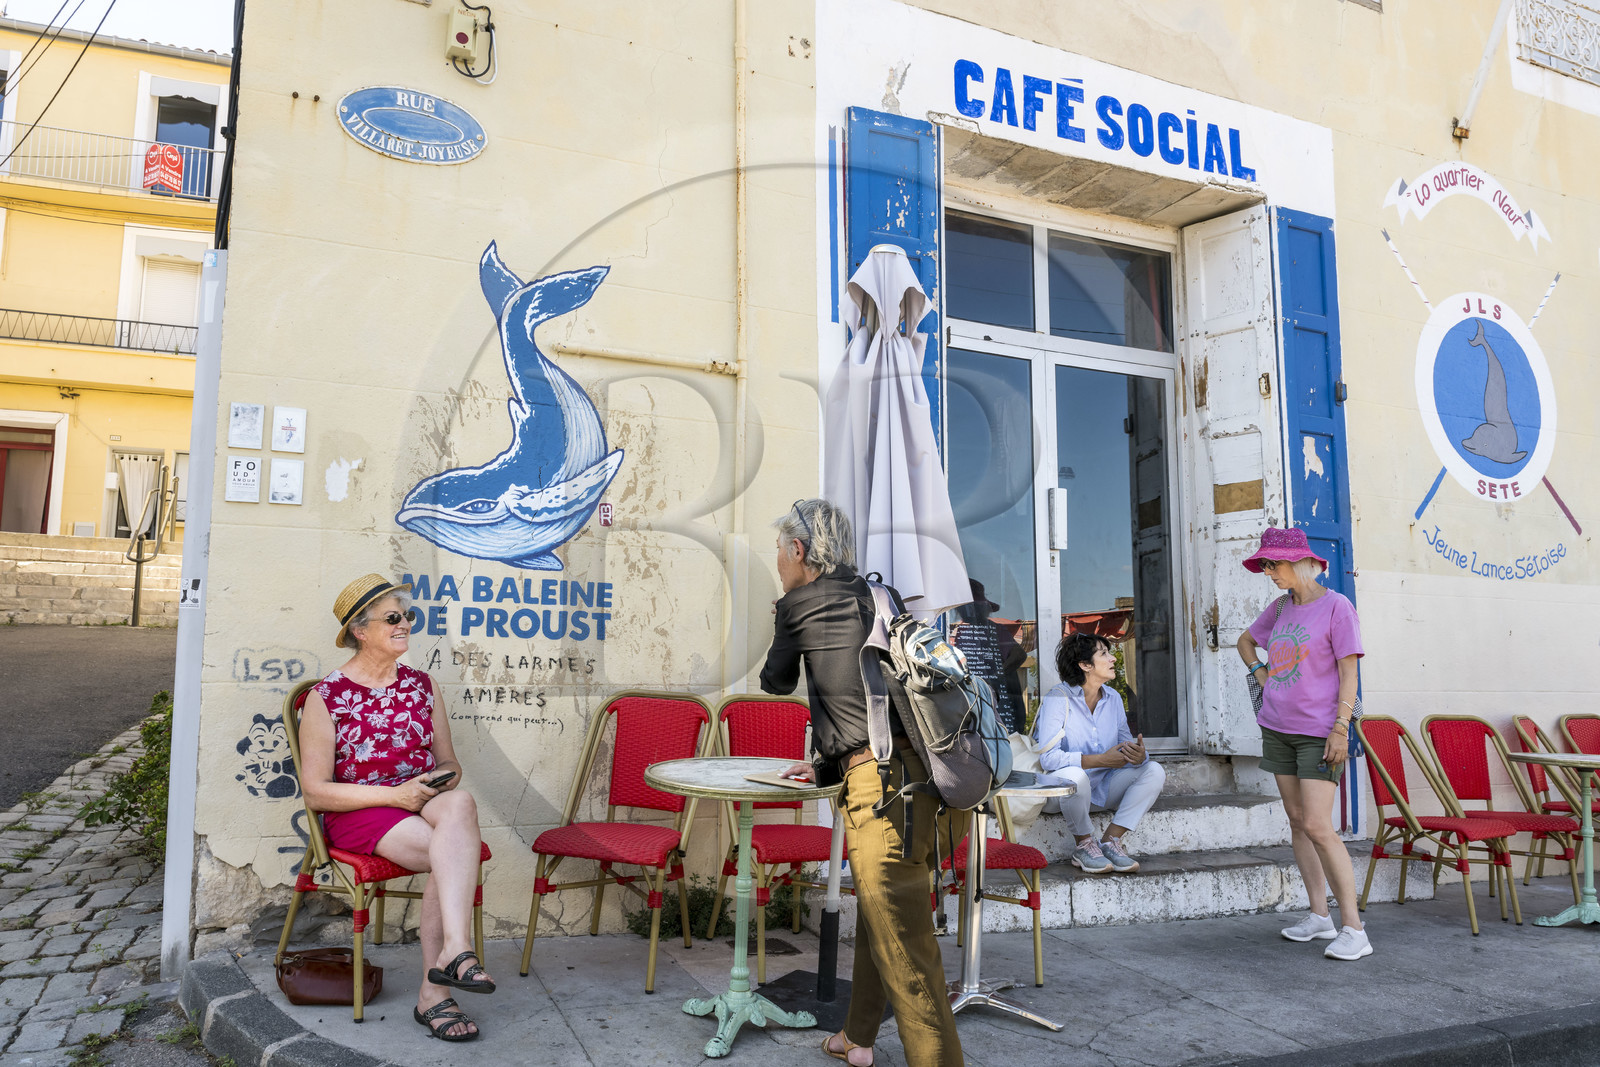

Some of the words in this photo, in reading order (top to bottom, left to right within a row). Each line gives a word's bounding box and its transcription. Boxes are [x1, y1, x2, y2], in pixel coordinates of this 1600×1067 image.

[396, 91, 435, 113] RUE
[953, 58, 1086, 143] CAFÉ
[1462, 298, 1502, 319] JLS
[1476, 479, 1522, 500] SETE
[1422, 524, 1468, 569] Jeune
[402, 573, 461, 602] MA
[472, 575, 614, 608] BALEINE
[408, 605, 448, 636] DE
[460, 606, 612, 642] PROUST
[243, 657, 306, 682] LSD
[427, 648, 442, 671] A
[451, 651, 493, 669] DES
[504, 655, 597, 675] LARMES
[1283, 670, 1304, 690] TEAM
[508, 714, 521, 724] qui
